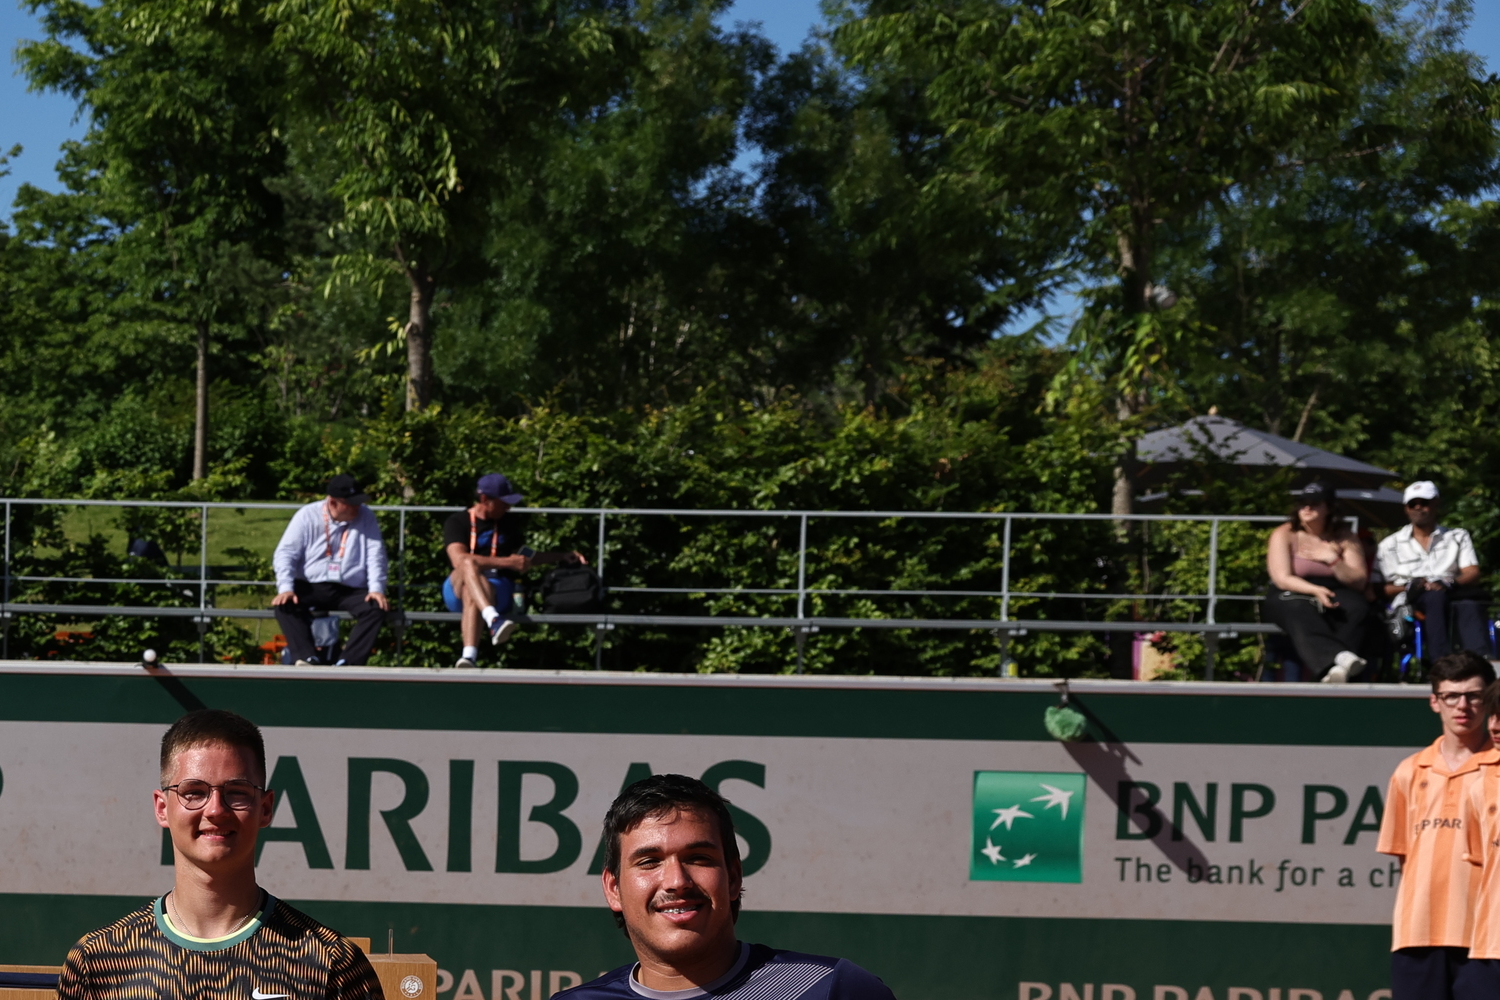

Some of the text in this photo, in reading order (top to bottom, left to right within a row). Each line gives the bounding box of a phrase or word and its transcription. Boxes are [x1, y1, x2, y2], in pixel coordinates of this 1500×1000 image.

[1115, 781, 1276, 843] BNP
[1115, 857, 1171, 883] The
[1187, 857, 1264, 884] bank
[1275, 859, 1325, 892] for
[1338, 867, 1355, 887] a
